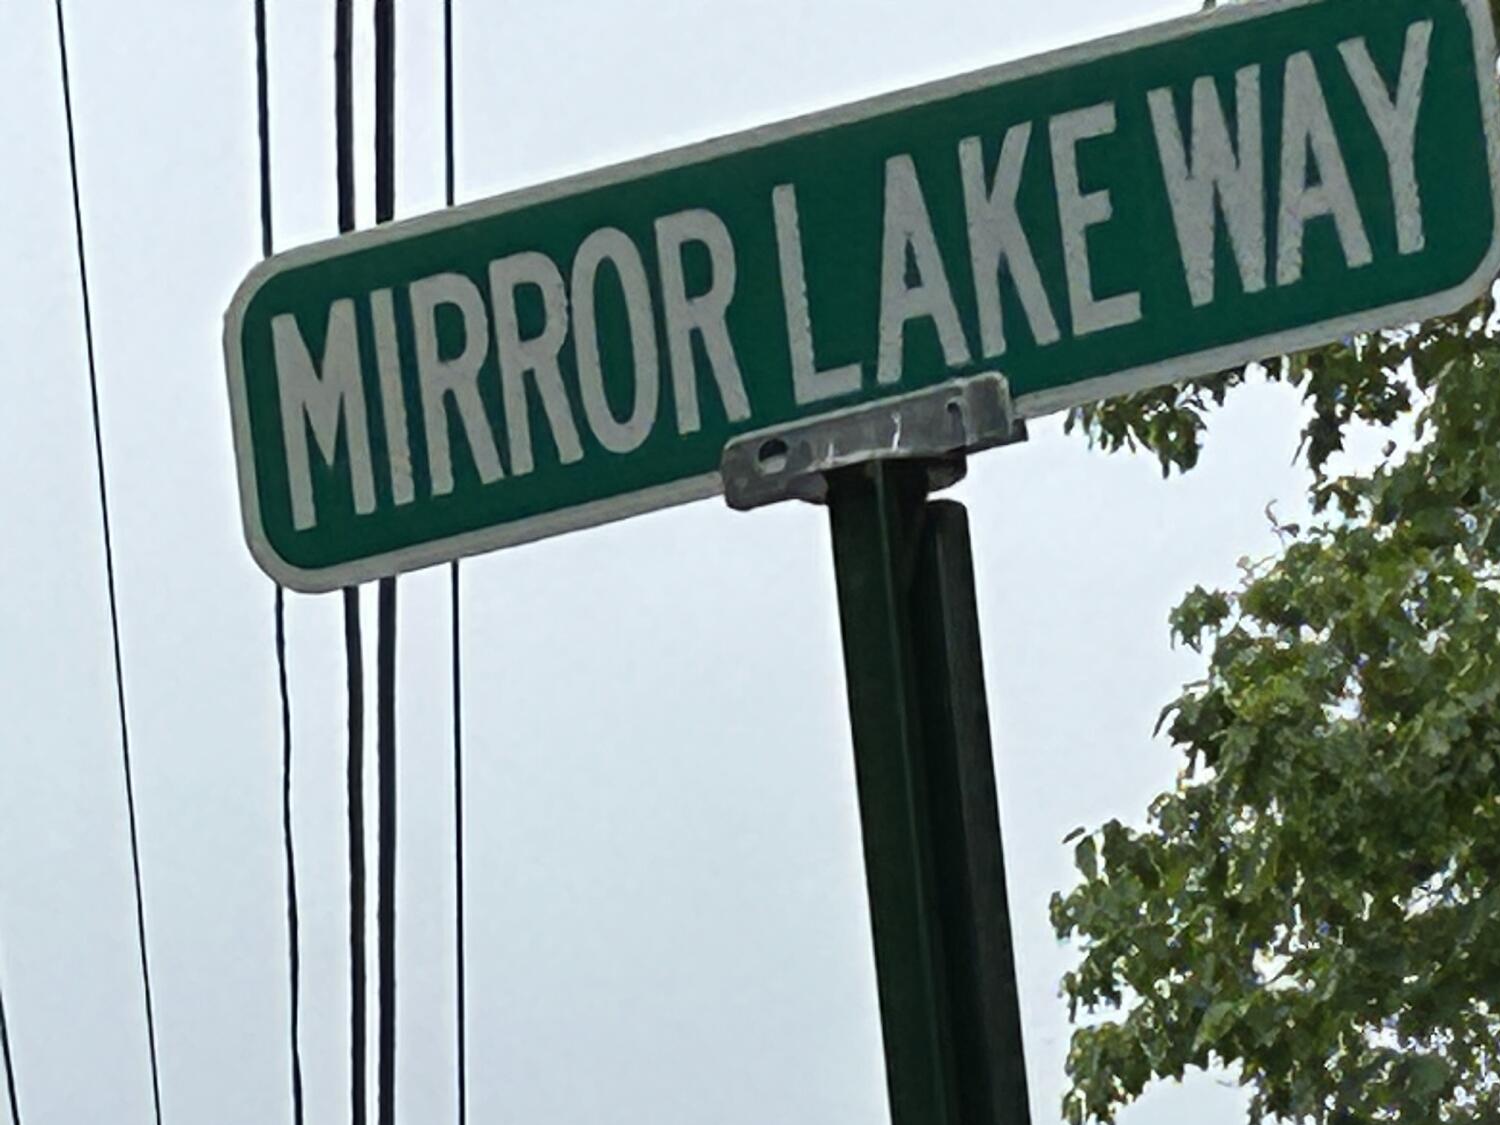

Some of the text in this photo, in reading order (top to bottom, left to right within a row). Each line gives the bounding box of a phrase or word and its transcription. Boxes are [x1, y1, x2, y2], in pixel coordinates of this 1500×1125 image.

[271, 19, 1434, 531] MIRROR LAKE WAY
